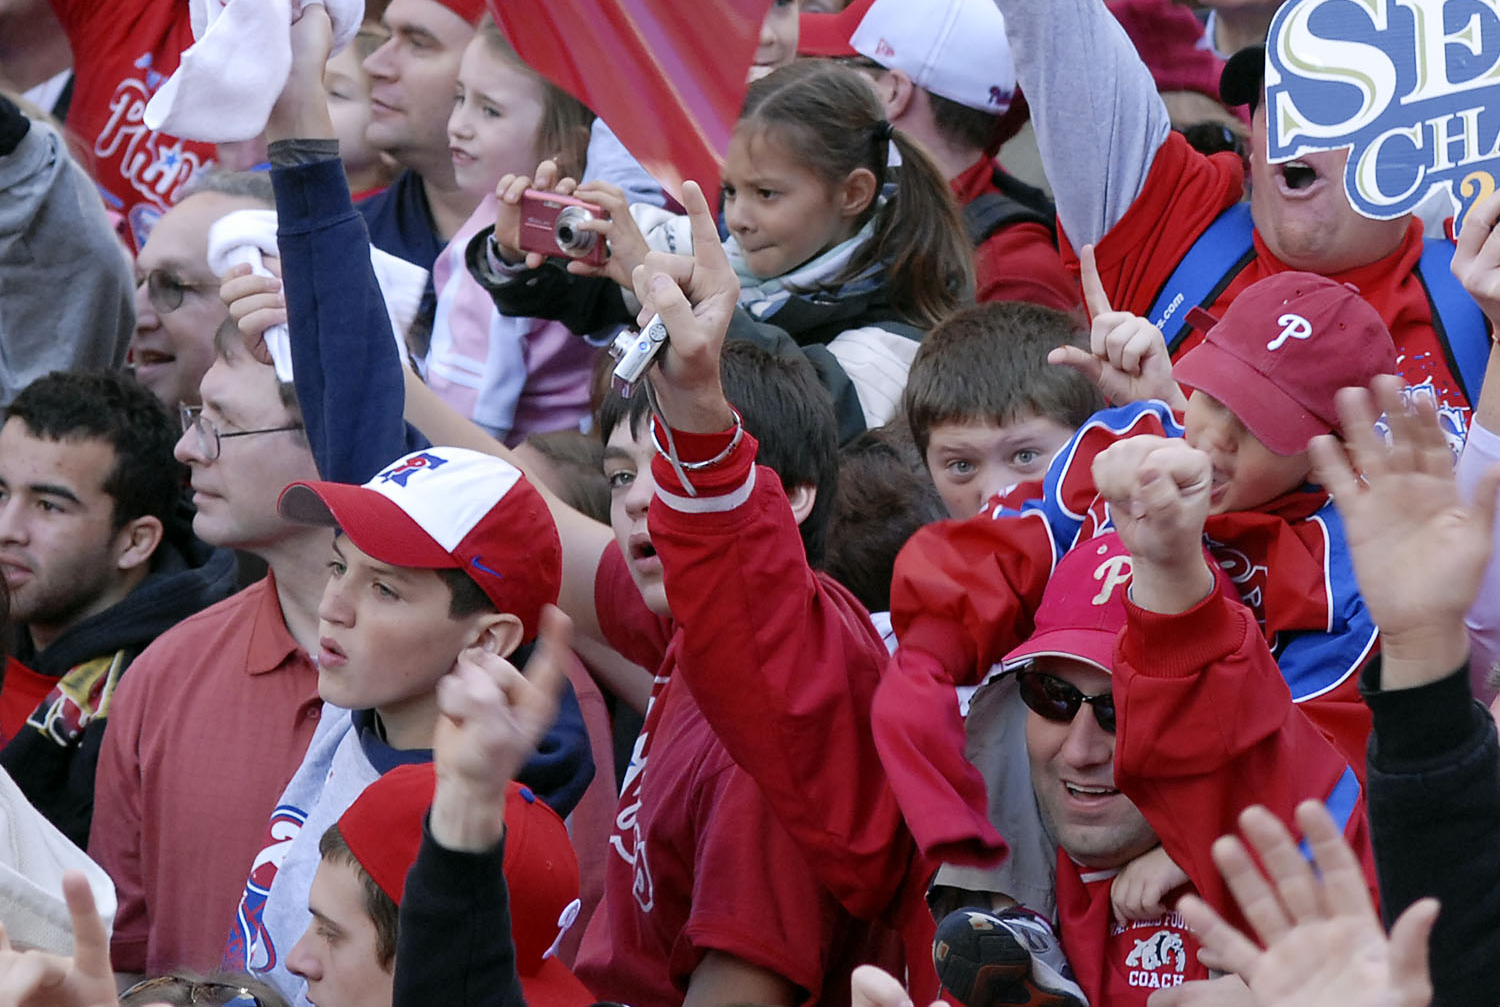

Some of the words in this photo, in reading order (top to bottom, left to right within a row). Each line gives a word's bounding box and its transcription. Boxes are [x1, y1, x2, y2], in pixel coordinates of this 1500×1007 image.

[1266, 312, 1313, 351] P
[1091, 554, 1134, 606] P
[1127, 969, 1185, 989] COACH
